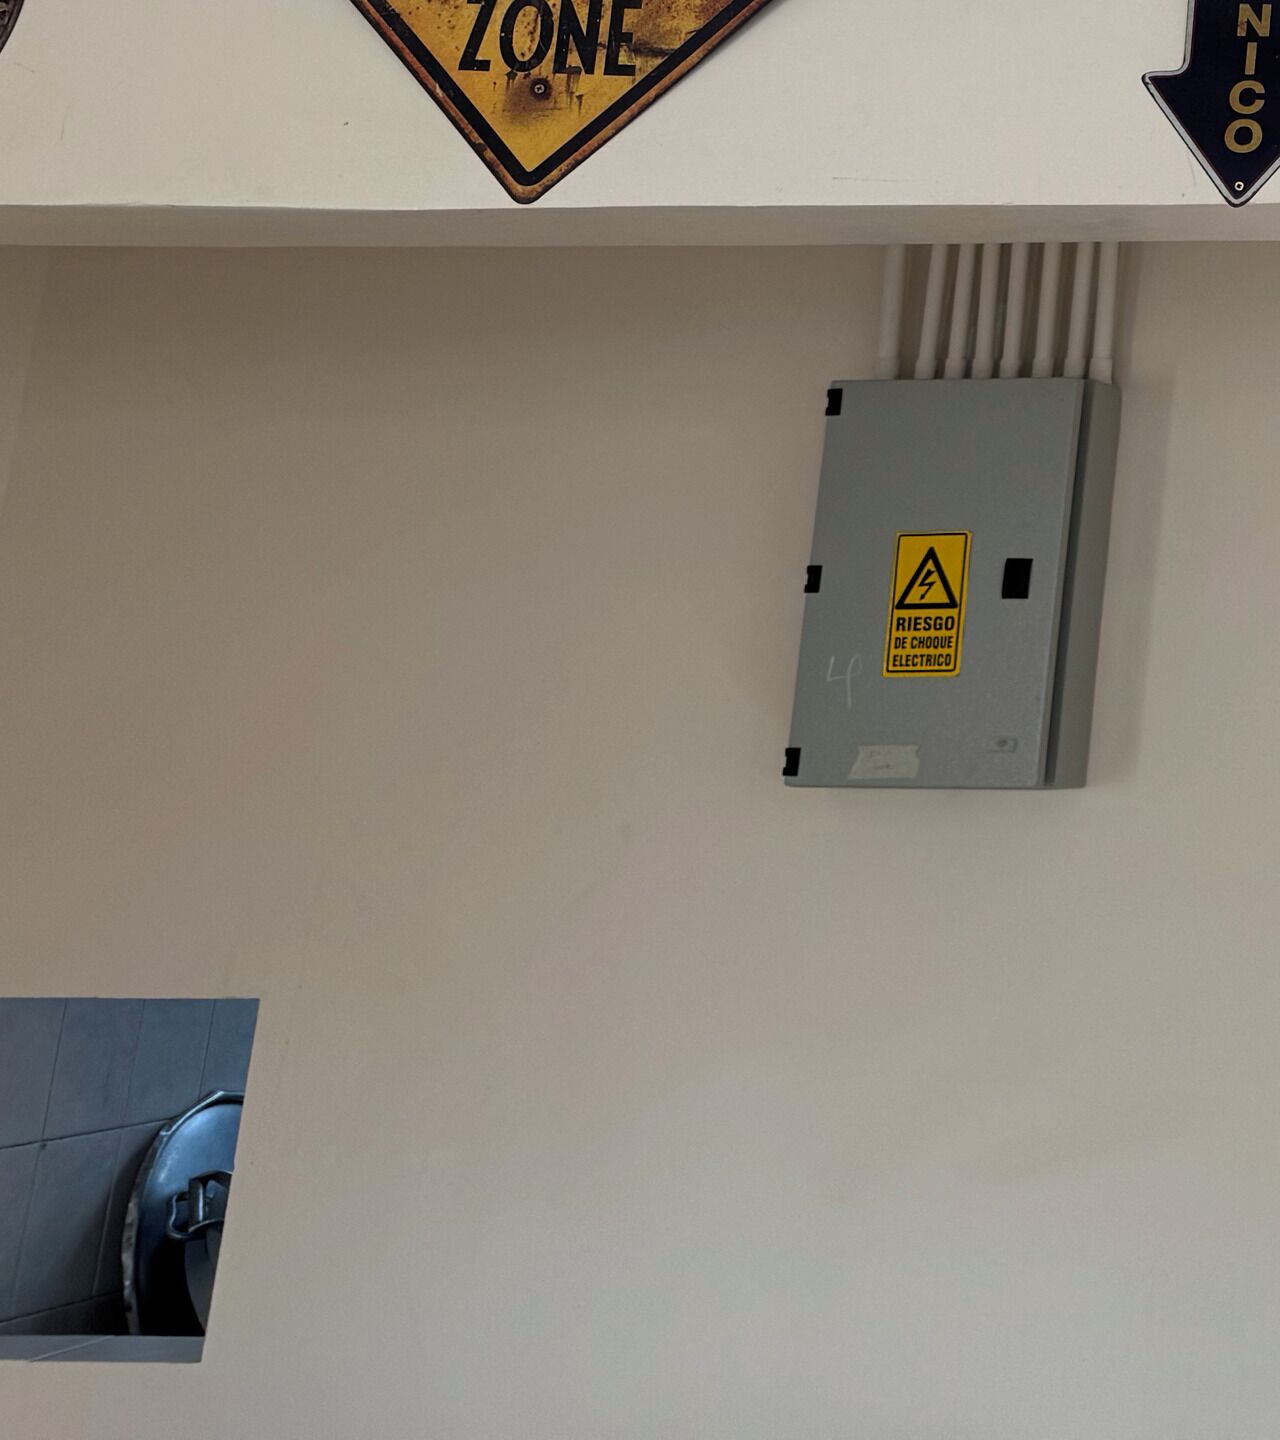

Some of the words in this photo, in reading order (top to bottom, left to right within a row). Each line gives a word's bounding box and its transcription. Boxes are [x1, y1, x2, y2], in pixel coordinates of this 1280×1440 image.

[895, 615, 956, 633] RIESGO
[893, 636, 908, 650] DE
[910, 635, 955, 650] CHOQUE
[892, 653, 953, 668] ELECTRICO
